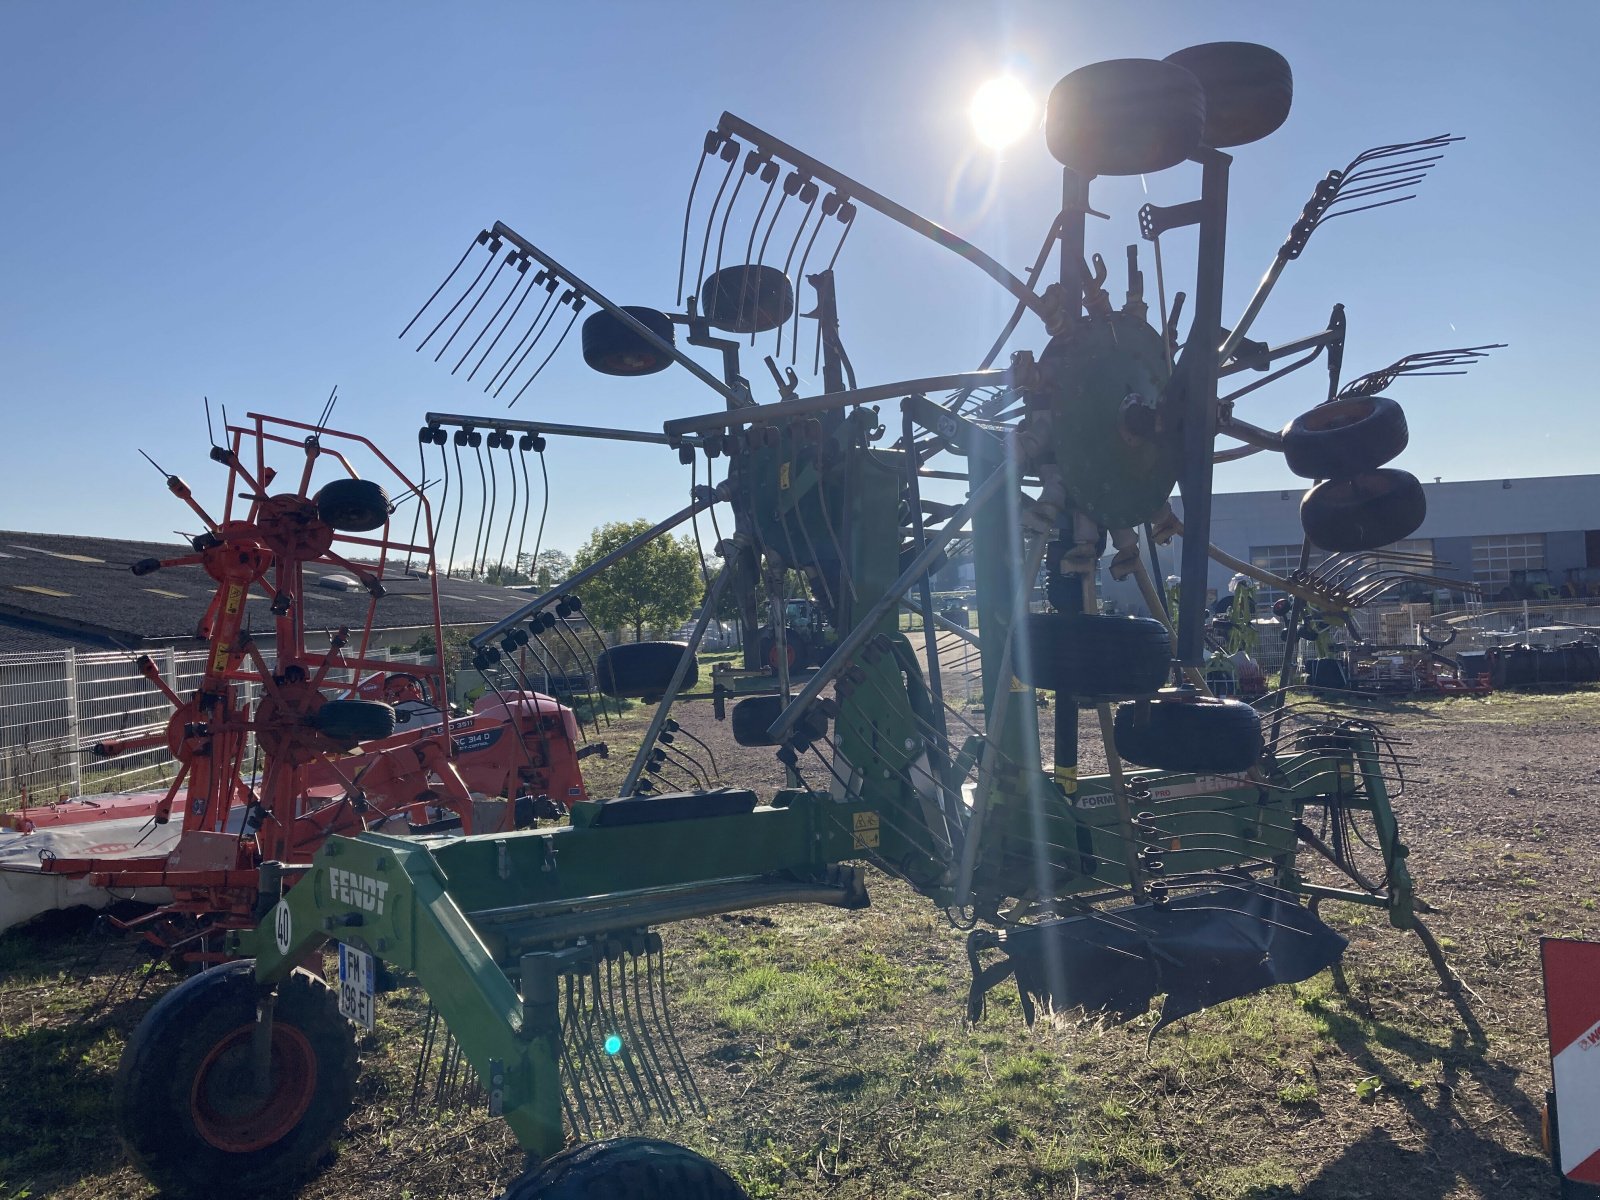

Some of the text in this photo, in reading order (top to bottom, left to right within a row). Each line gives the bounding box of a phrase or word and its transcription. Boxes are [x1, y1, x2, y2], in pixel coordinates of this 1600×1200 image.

[1154, 789, 1171, 798] PRO
[329, 867, 389, 915] FENDT
[277, 906, 289, 948] 40
